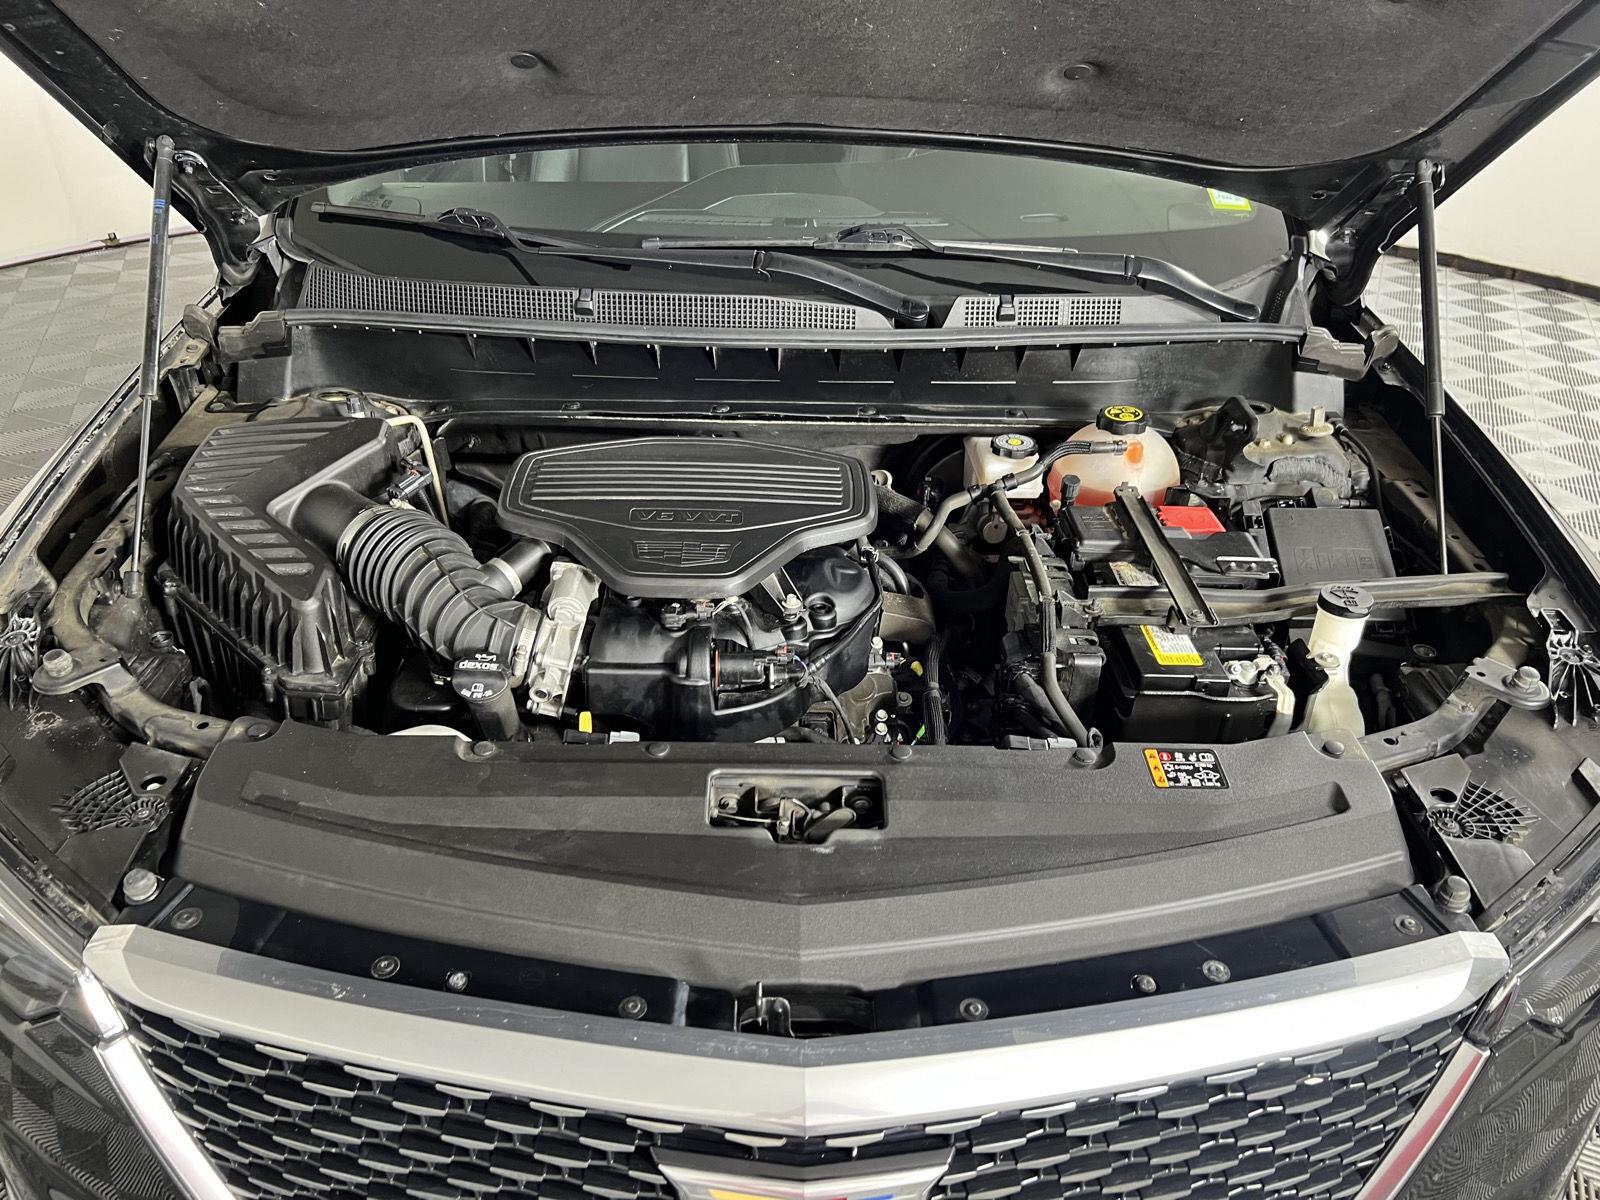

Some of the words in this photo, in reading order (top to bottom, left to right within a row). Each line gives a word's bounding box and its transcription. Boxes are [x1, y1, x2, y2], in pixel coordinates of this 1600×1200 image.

[639, 510, 674, 521] V6
[684, 511, 739, 522] VVT
[459, 660, 499, 670] dexos
